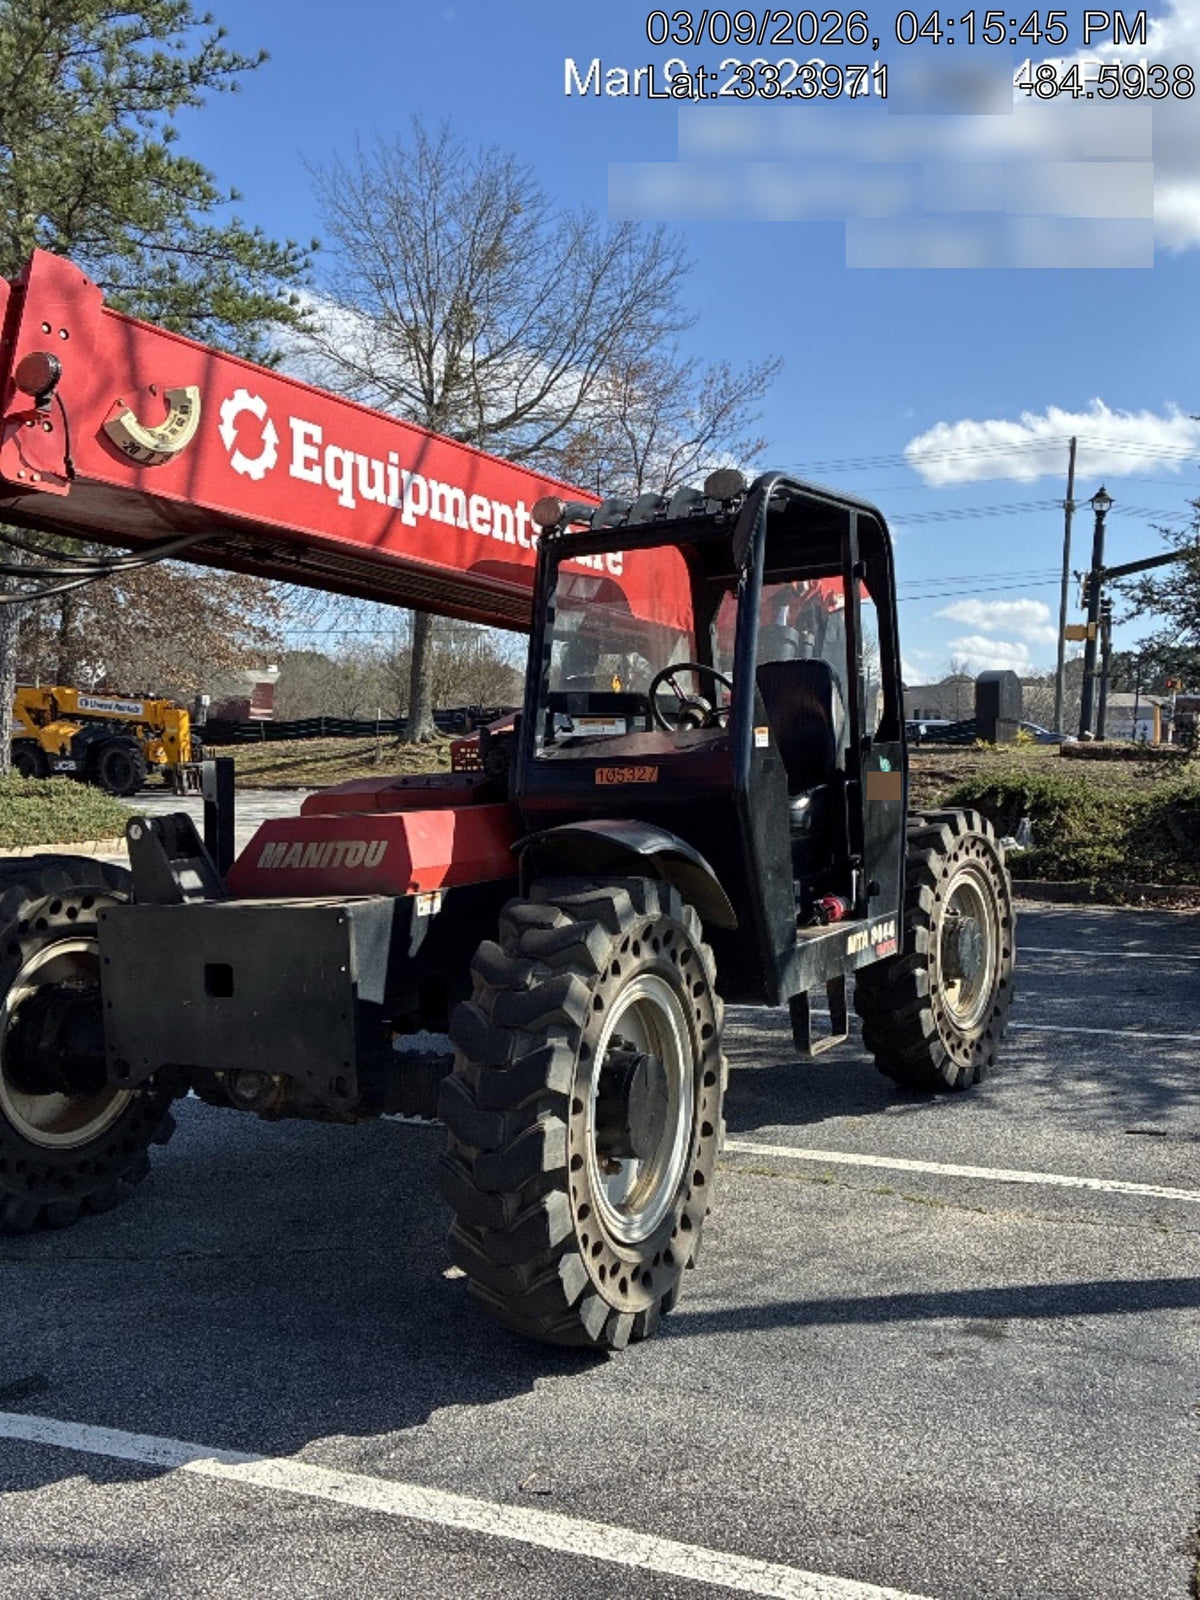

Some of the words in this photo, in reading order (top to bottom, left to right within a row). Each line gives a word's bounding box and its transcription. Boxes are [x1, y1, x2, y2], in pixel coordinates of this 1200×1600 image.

[54, 760, 77, 771] JCB
[597, 765, 657, 783] 105327
[256, 840, 389, 869] MANITOU
